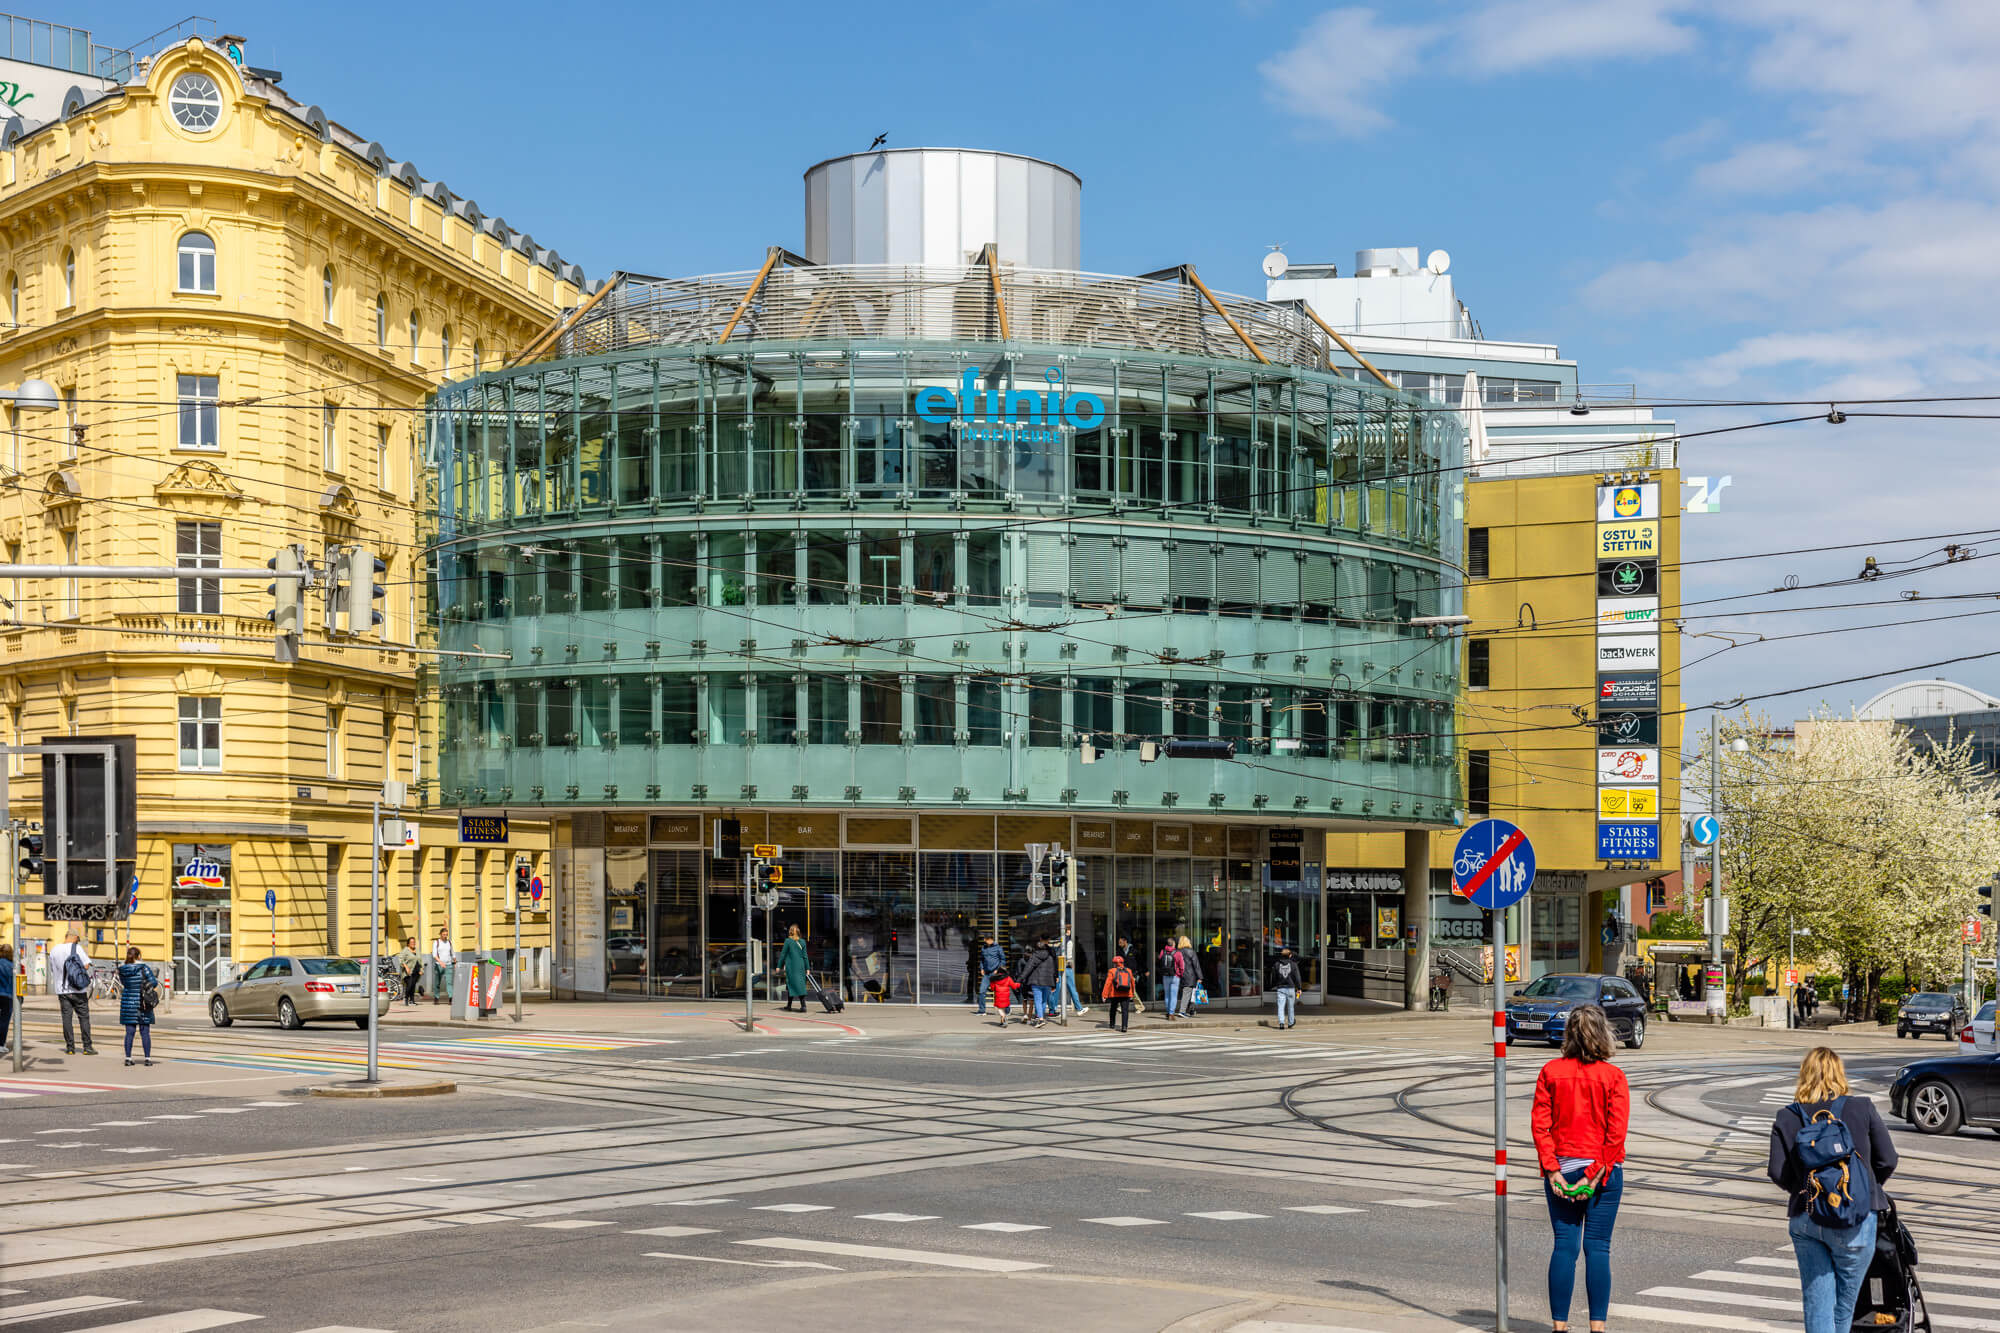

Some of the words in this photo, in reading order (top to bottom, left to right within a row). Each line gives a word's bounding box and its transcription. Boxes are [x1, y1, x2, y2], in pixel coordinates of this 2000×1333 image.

[915, 366, 1105, 429] efinio
[961, 428, 1061, 443] INGENIEURE
[1603, 540, 1652, 552] STETTIN
[1600, 609, 1655, 622] SUBWAY
[1632, 803, 1644, 811] 99
[468, 819, 496, 827] STARS
[464, 826, 500, 835] FITNESS
[797, 826, 812, 834] BAR
[1608, 827, 1648, 837] STARS
[1602, 838, 1655, 848] FITNESS
[185, 858, 219, 877] dm
[1356, 872, 1402, 890] KING
